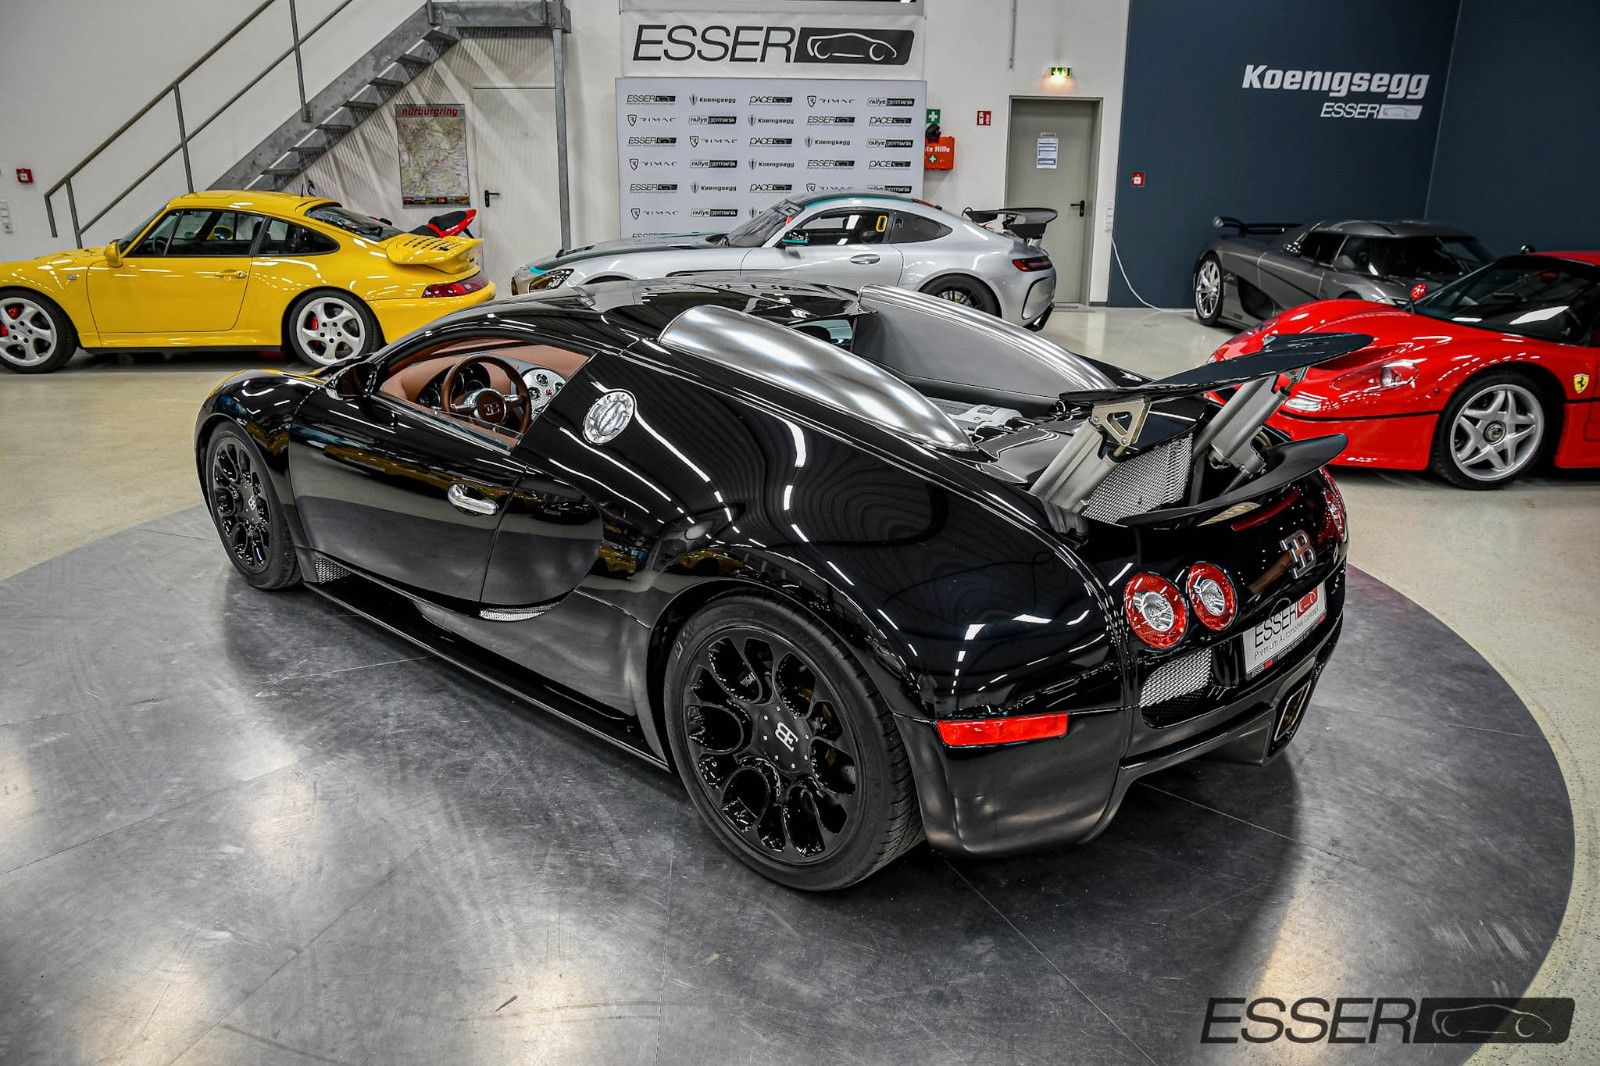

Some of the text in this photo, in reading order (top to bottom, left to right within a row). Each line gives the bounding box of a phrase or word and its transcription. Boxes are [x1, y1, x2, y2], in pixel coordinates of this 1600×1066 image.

[632, 24, 796, 63] ESSER
[1242, 64, 1430, 100] Koenigsegg
[1320, 102, 1380, 119] ESSER
[1255, 602, 1297, 648] ESSER
